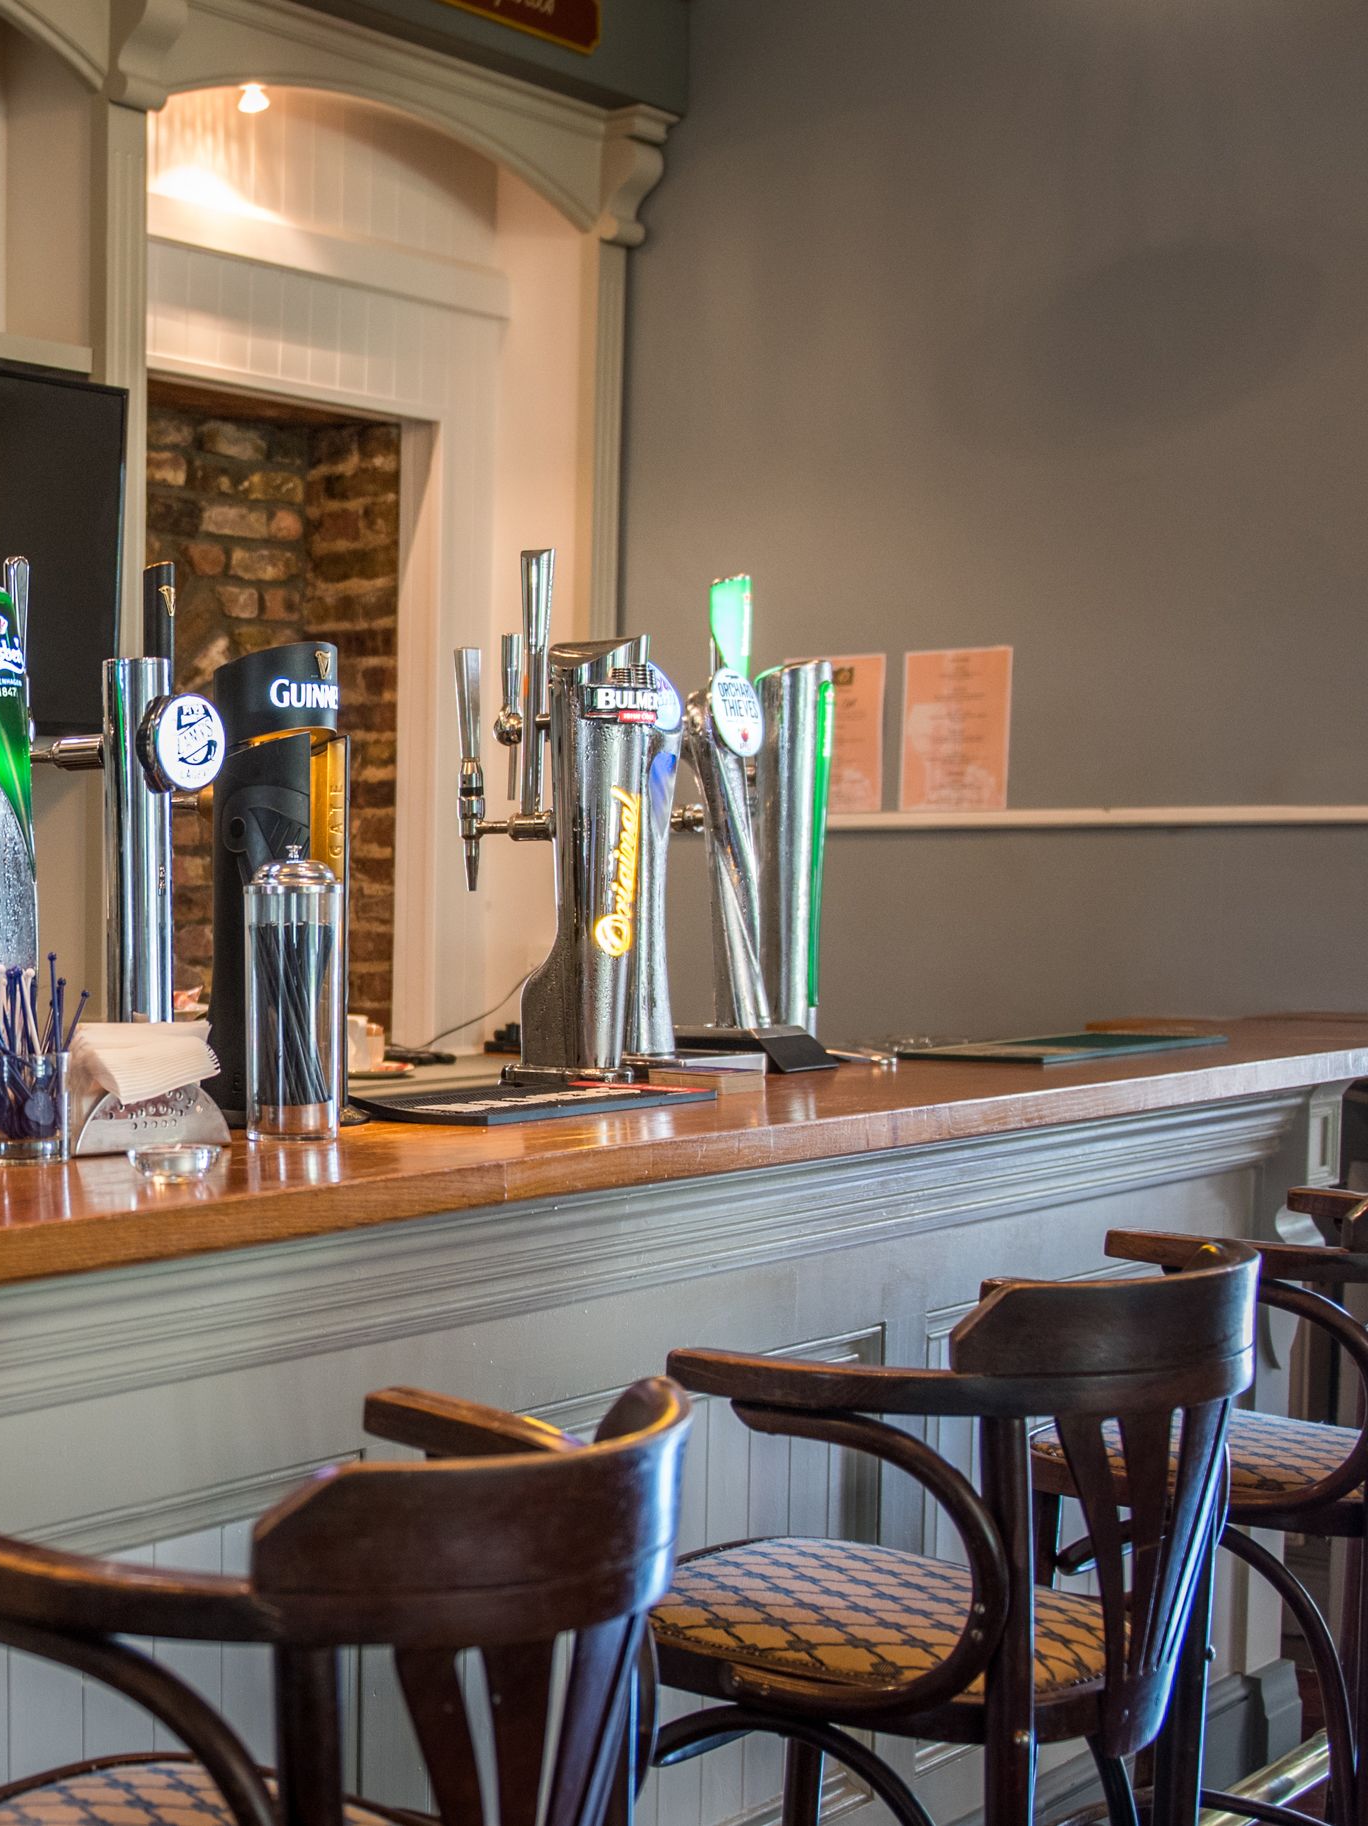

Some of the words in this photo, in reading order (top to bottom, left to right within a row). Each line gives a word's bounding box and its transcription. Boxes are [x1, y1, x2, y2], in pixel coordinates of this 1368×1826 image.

[721, 698, 760, 719] THIEVES
[329, 783, 345, 858] GATE
[594, 785, 641, 957] Original
